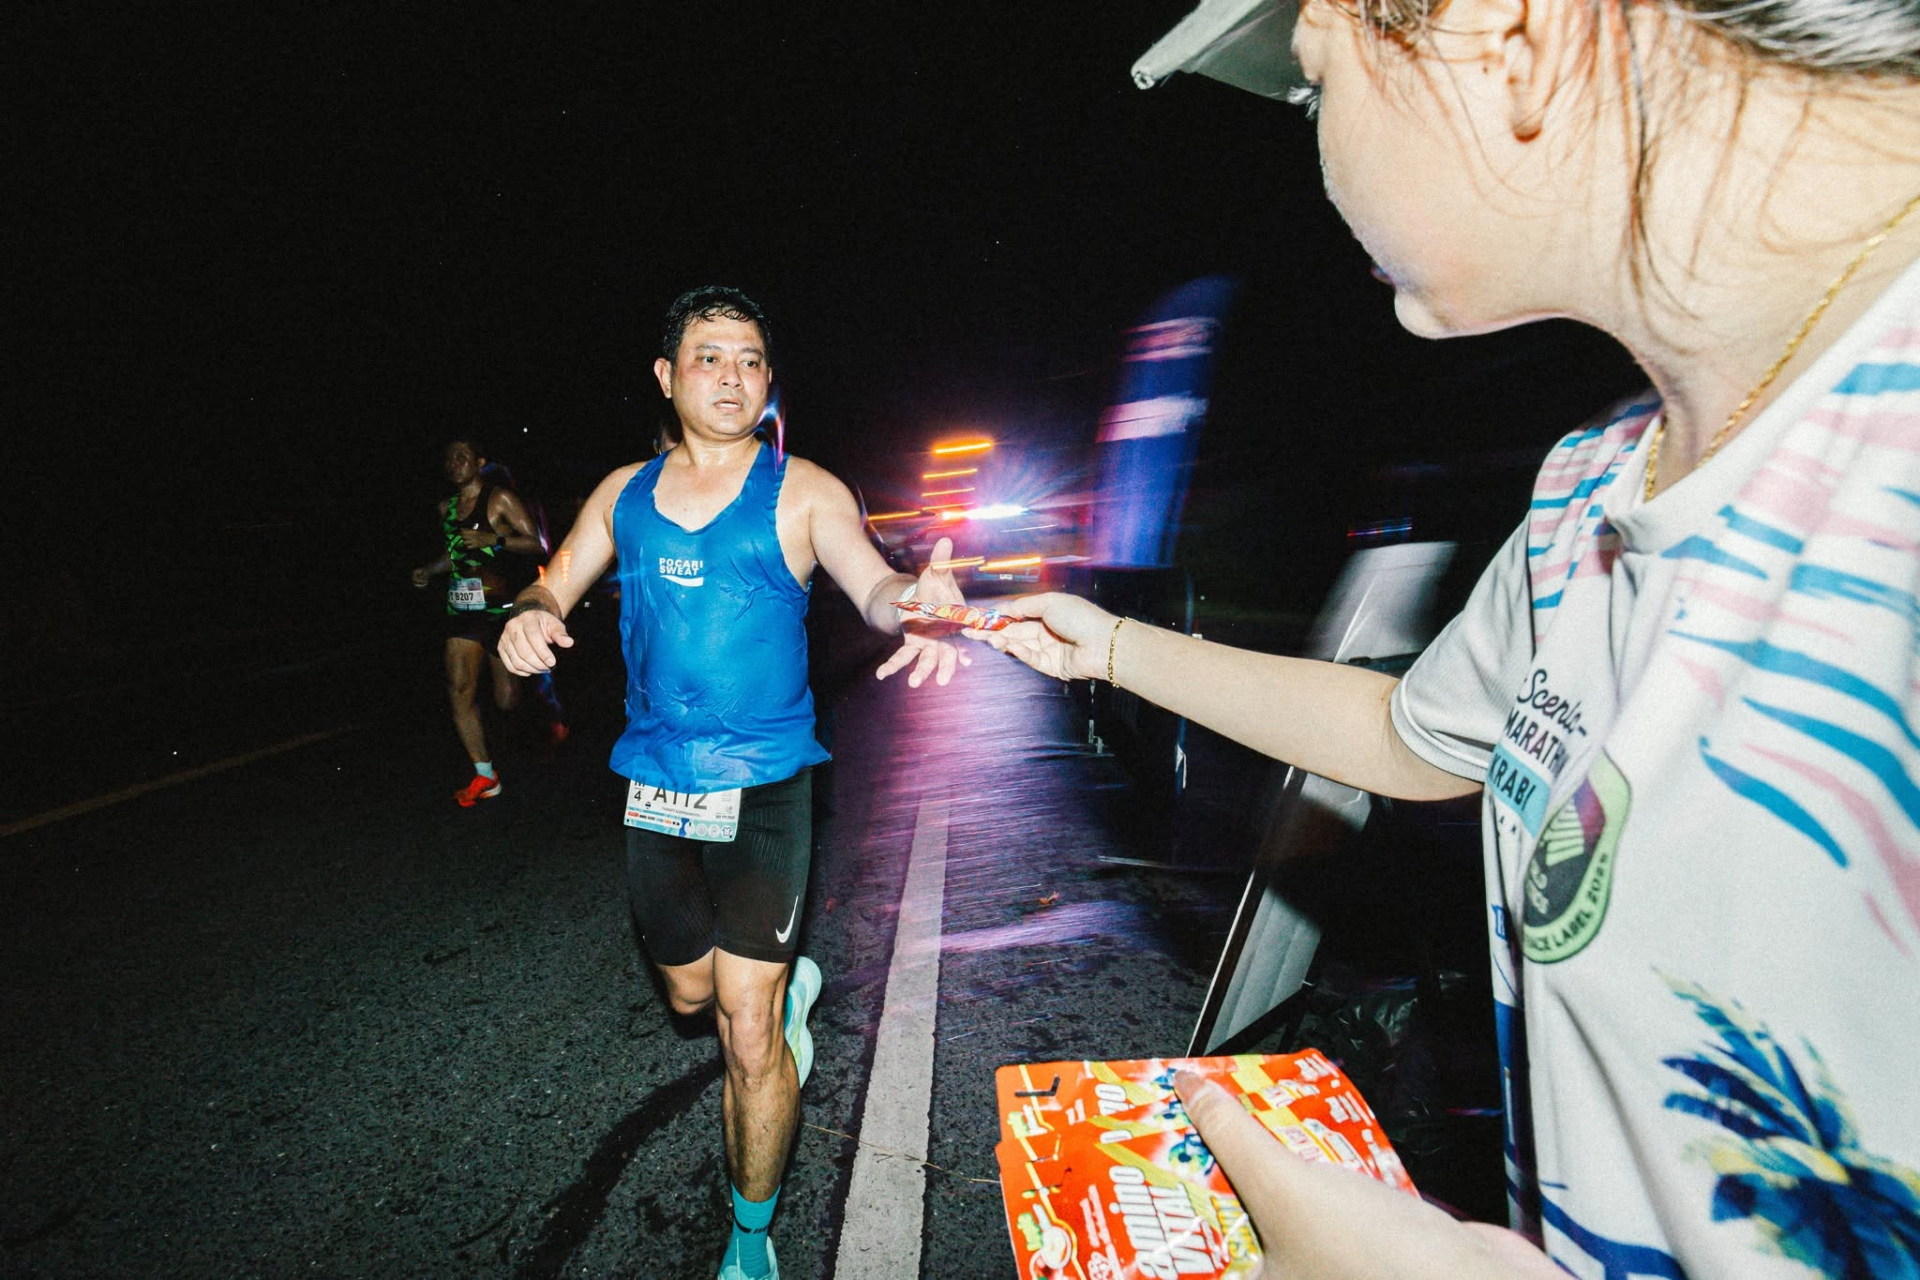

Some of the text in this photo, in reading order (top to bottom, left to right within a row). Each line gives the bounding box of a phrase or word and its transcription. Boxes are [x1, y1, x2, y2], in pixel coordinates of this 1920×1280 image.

[659, 557, 703, 569] POCARI
[659, 565, 698, 576] SWEAT
[1503, 707, 1569, 779] MARATH
[633, 790, 642, 802] 4
[1489, 752, 1537, 812] KRABI
[1553, 910, 1592, 947] LABEL
[1108, 1165, 1179, 1280] amino
[1148, 1182, 1216, 1275] VITAL
